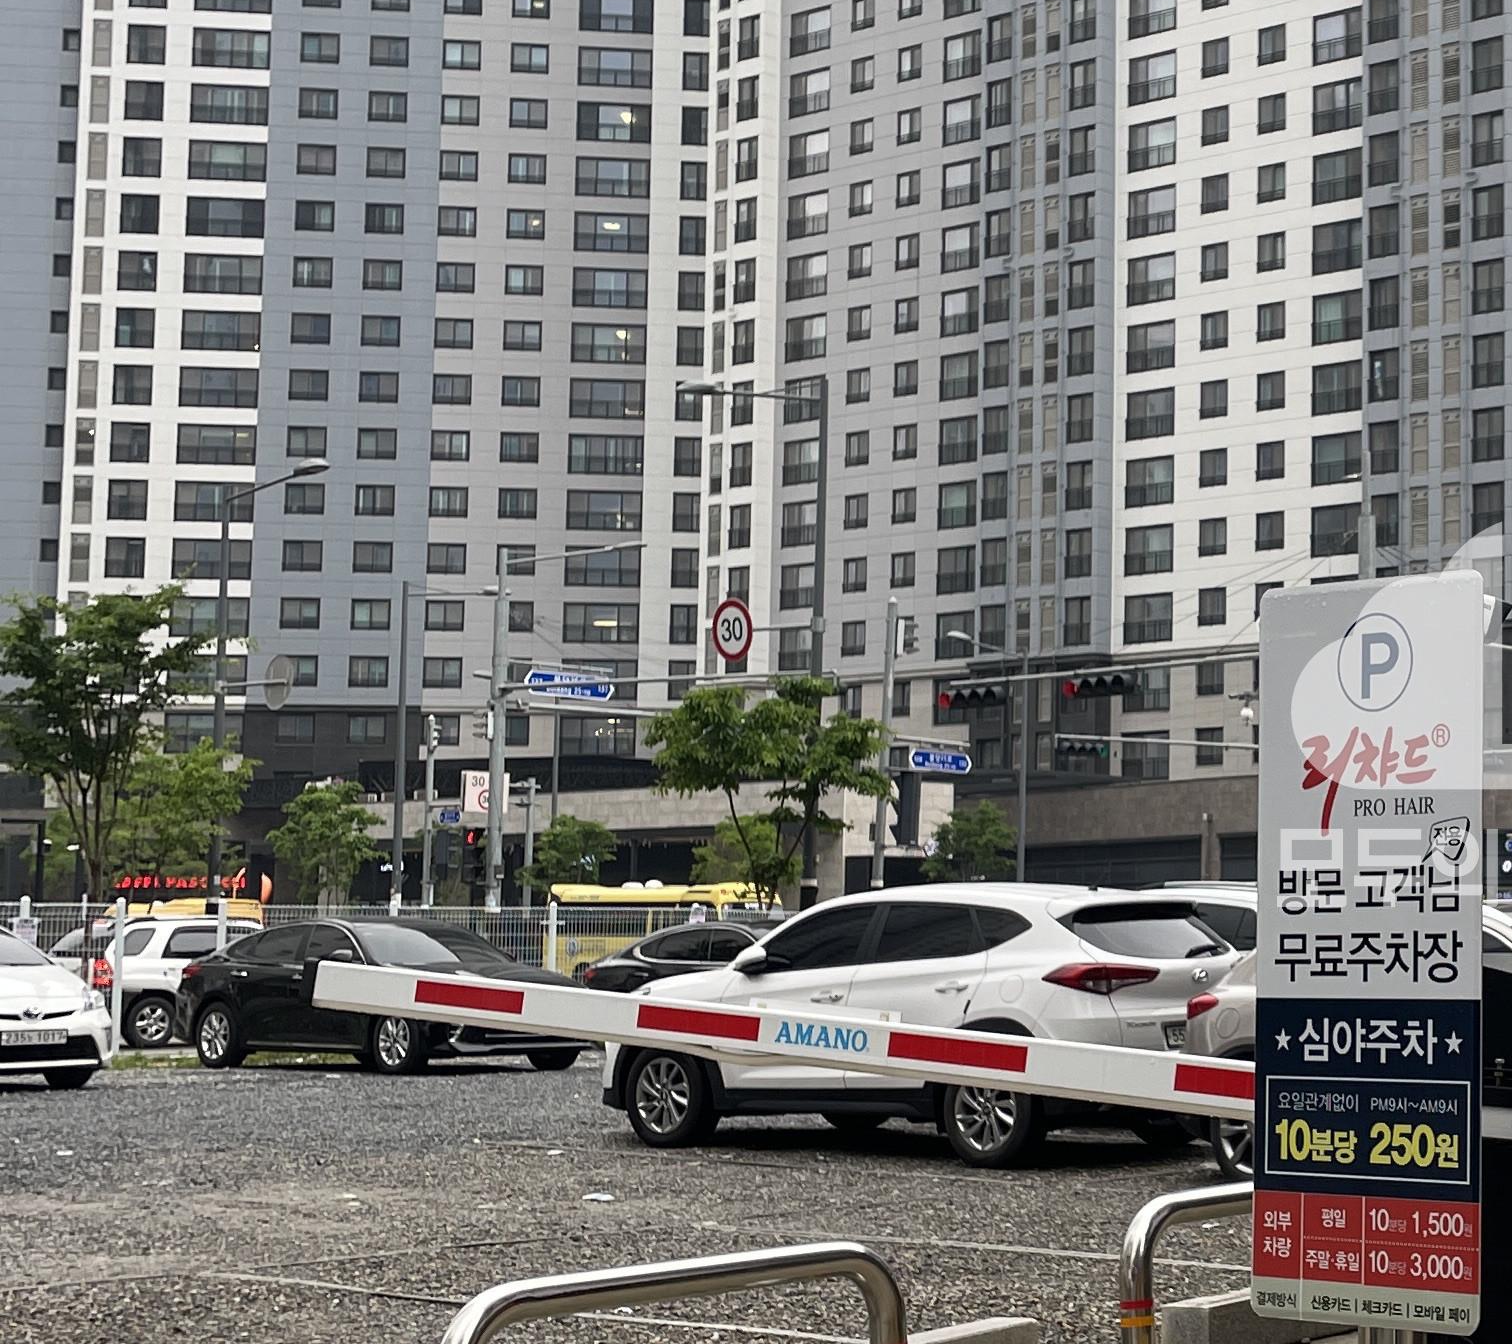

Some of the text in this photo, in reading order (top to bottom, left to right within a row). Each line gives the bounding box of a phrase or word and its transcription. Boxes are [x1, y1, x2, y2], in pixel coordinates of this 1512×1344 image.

[721, 616, 743, 643] 30
[1361, 632, 1399, 699] P
[472, 776, 485, 787] 30
[1354, 796, 1436, 817] PRO HAIR
[1433, 826, 1461, 847] 전용
[1279, 864, 1460, 915] 방문 고객님
[1274, 930, 1463, 983] 무료주차장
[775, 1021, 867, 1052] AMANO
[1298, 1018, 1438, 1065] 심야주차
[1278, 1092, 1359, 1113] 요일관계없이
[1275, 1119, 1459, 1168] 10분당 250원
[1263, 1211, 1292, 1232] 외부
[1321, 1208, 1346, 1229] 평일
[1263, 1237, 1292, 1258] 차량
[1256, 1291, 1471, 1324] 결제방식 신용카드 체크카드 모바일 페이
